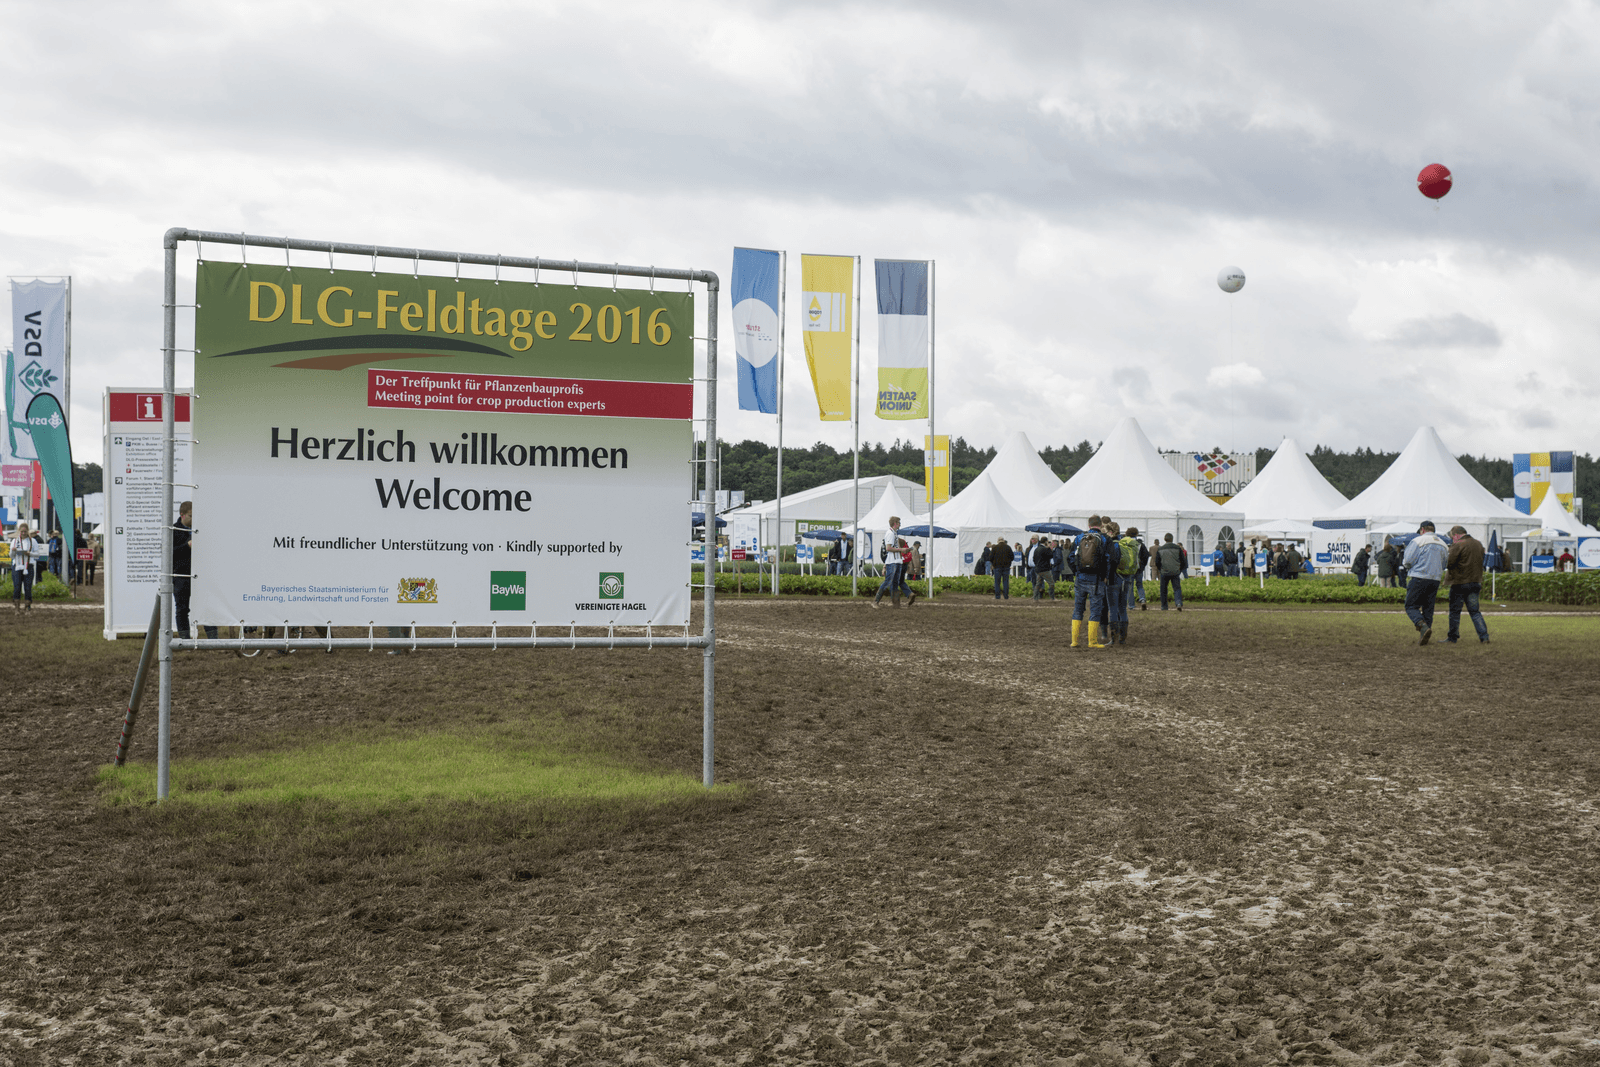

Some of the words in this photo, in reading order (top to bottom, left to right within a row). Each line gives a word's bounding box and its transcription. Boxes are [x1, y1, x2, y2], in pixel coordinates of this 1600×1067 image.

[248, 280, 557, 352] DLG-Feldtage
[568, 302, 672, 347] 2016
[375, 375, 398, 386] Der
[402, 376, 461, 391] Treffpunkt
[465, 379, 482, 390] für
[485, 380, 584, 397] Pflanzenbauprofis
[375, 391, 421, 405] Meeting
[424, 392, 455, 406] point
[457, 393, 473, 405] for
[476, 397, 501, 408] crop
[505, 396, 564, 409] production
[567, 400, 606, 412] experts
[270, 427, 416, 462] Herzlich
[429, 432, 629, 469] willkommen
[375, 477, 532, 512] Welcome
[273, 536, 295, 548] Mit
[300, 536, 377, 550] freundlicher
[381, 538, 468, 555] Unterstützung
[472, 543, 494, 552] von
[506, 541, 543, 556] Kindly
[547, 541, 605, 556] supported
[609, 541, 623, 556] by
[1327, 542, 1351, 553] SAATEN
[243, 594, 286, 603] Ernährung,
[288, 594, 343, 602] Landwirtschaft
[361, 595, 389, 603] Forsten
[261, 585, 306, 594] Bayerisches
[308, 585, 377, 594] Staatsministerium
[492, 584, 524, 596] BayWa
[575, 603, 620, 611] VEREINIGTE
[621, 603, 647, 611] HAGEL
